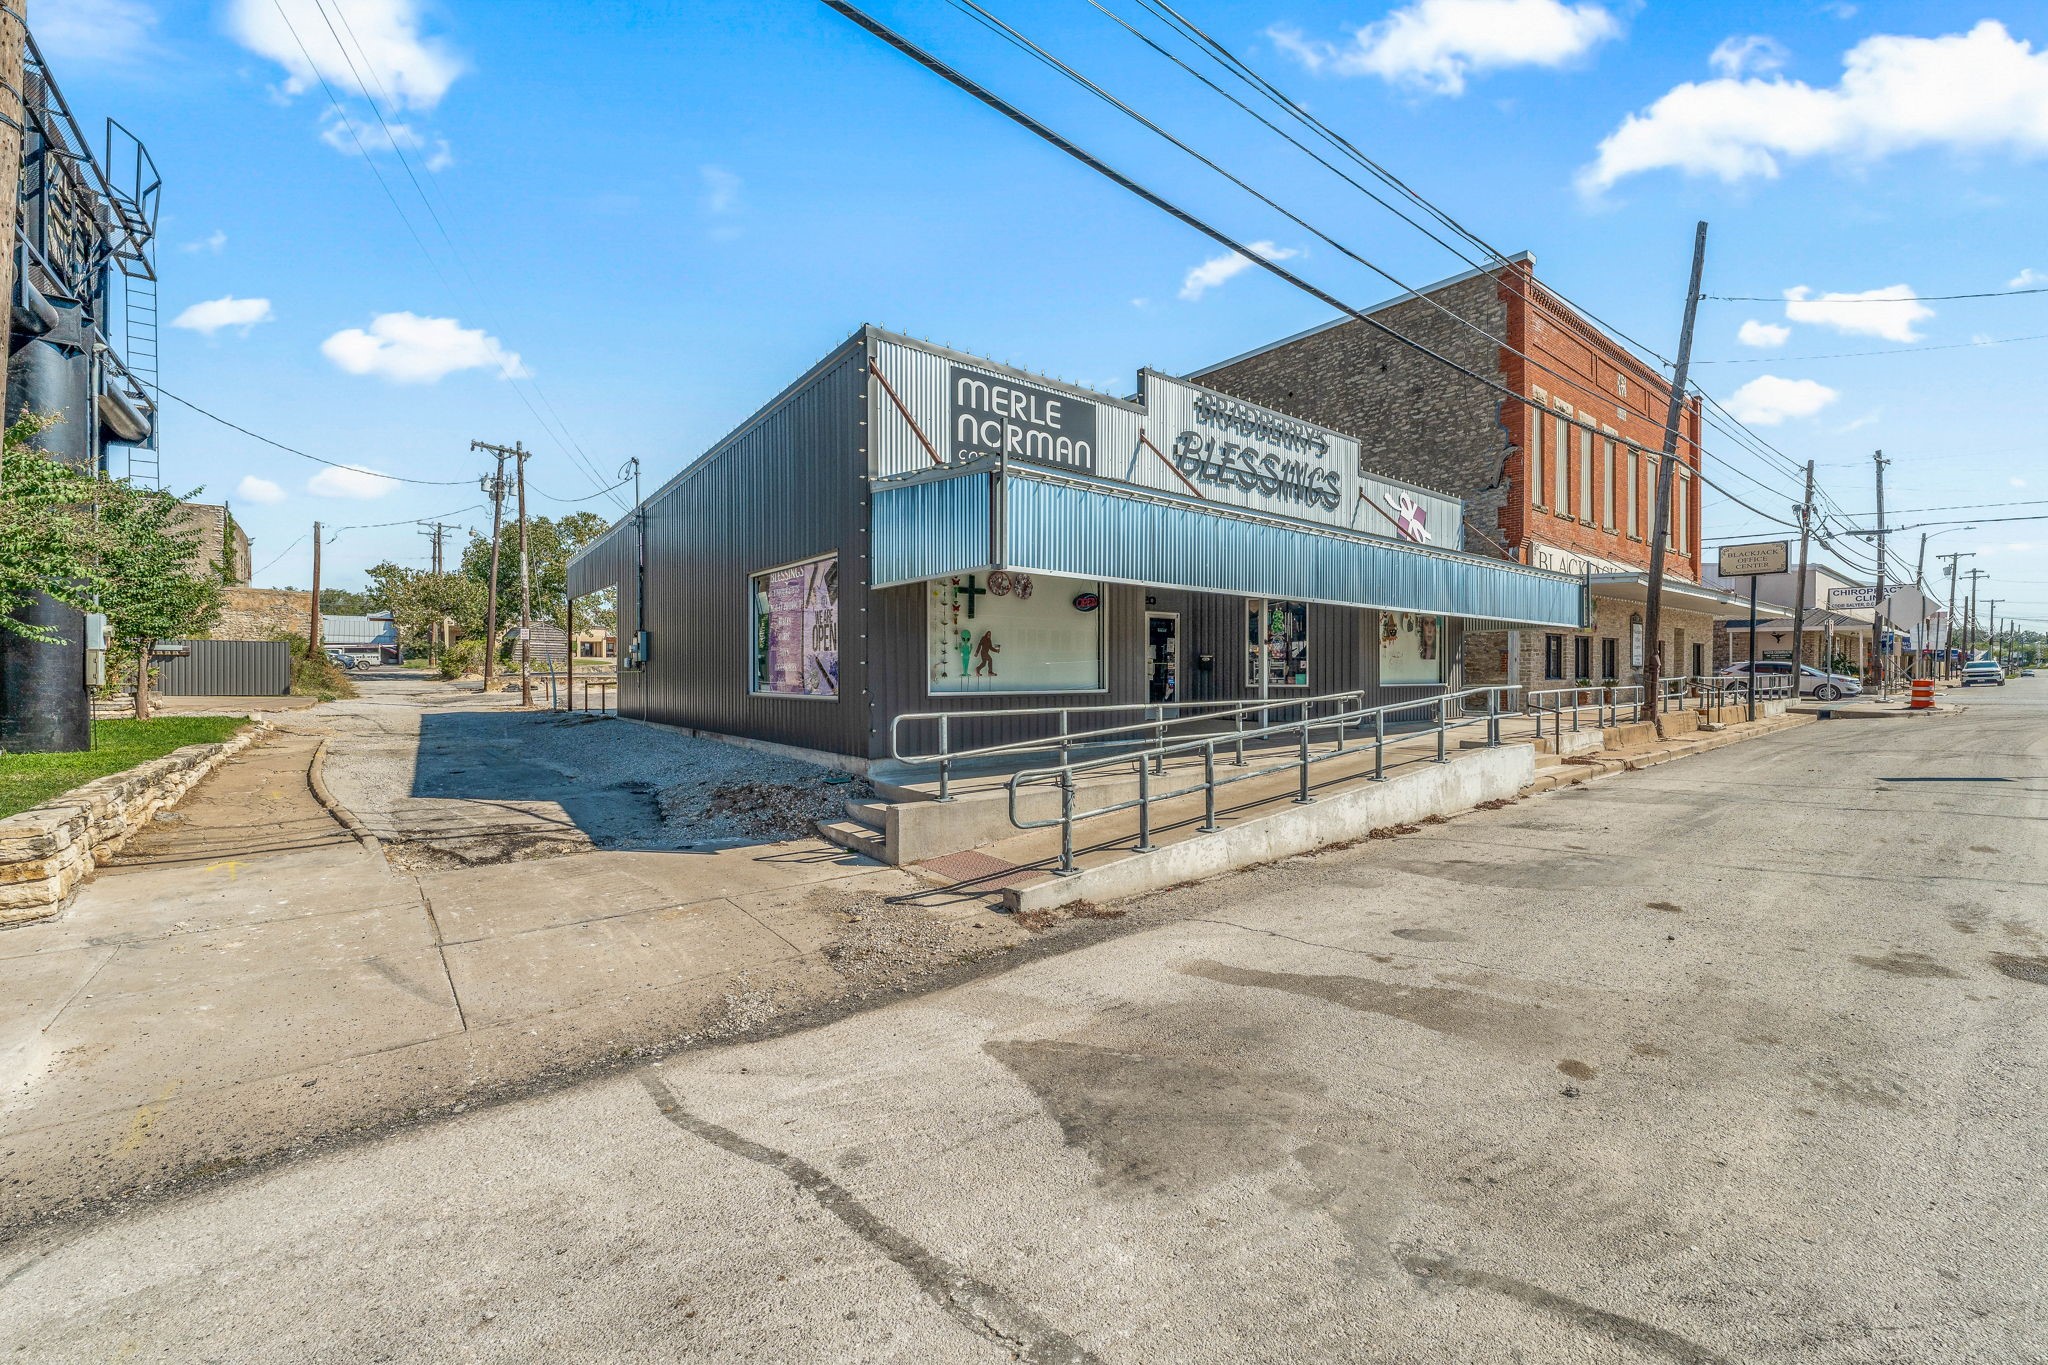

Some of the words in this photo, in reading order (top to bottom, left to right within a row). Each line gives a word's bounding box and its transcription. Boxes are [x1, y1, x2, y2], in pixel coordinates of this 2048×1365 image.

[957, 377, 1061, 430] MERLE
[957, 413, 1091, 469] NORMAN
[1176, 430, 1342, 508] BLESSINGS
[1727, 549, 1779, 559] BLACKJACK
[1735, 562, 1769, 570] CENTER
[815, 610, 823, 625] WE
[824, 608, 833, 624] ARE
[812, 622, 837, 652] OPEN
